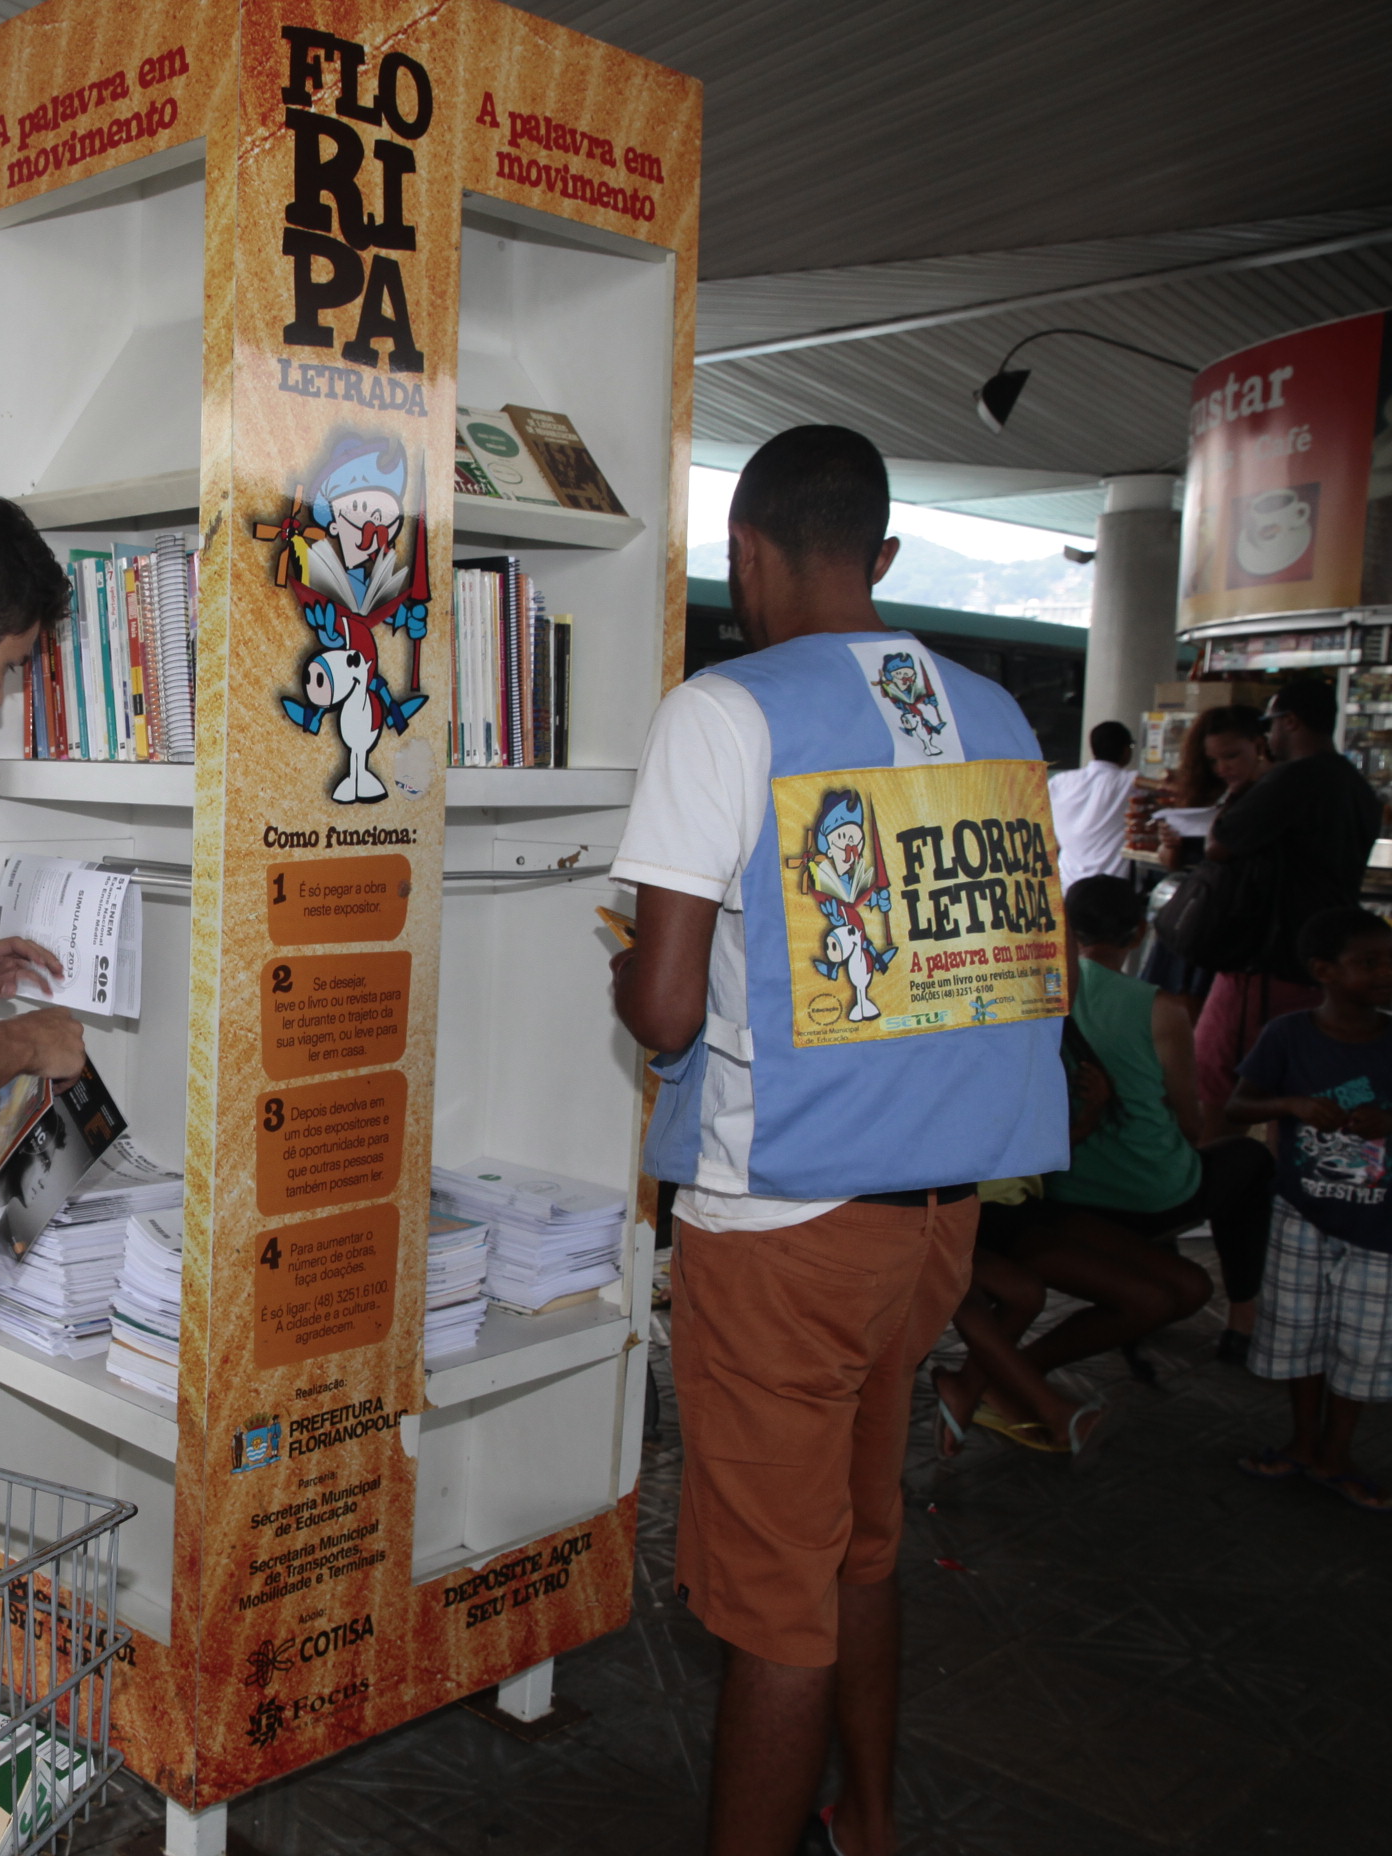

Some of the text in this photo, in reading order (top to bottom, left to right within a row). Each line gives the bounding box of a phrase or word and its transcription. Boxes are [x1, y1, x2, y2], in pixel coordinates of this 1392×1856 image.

[17, 70, 129, 152] palavra
[138, 44, 189, 89] em
[281, 25, 433, 140] FLO
[7, 97, 178, 189] movimento
[476, 91, 664, 184] A palavra em
[285, 108, 416, 252] RI
[496, 151, 655, 222] movimento
[283, 226, 425, 374] PA
[277, 357, 428, 418] LETRADA
[1255, 424, 1312, 460] Café
[263, 826, 418, 848] Como funciona:
[896, 818, 1053, 887] FLORIPA
[273, 873, 286, 905] 1
[299, 880, 386, 901] É só pegar a obra
[106, 878, 124, 936] S1 ENEM
[304, 902, 381, 917] neste expositor.
[901, 880, 1056, 942] LETRADA
[67, 890, 85, 978] SIMULADO 2013
[910, 952, 922, 973] A
[925, 948, 989, 978] palavra
[992, 944, 1013, 963] em
[272, 964, 293, 994] 2
[313, 975, 366, 991] Se desejar,
[910, 969, 1016, 992] Pegue um livro ou revista.
[911, 984, 994, 1003] DOAÇÕES (48) 3251-6100
[274, 989, 401, 1013] leve o livro ou revista para
[282, 1007, 393, 1030] ler durante o trajeto da
[276, 1024, 398, 1050] sua viagem, ou leve para
[308, 1044, 366, 1062] ler em casa.
[264, 1098, 284, 1132] 3
[290, 1097, 385, 1122] Depois devolva em
[284, 1115, 389, 1141] um dos expositores e
[283, 1132, 389, 1161] dê oportunidade para
[288, 1152, 384, 1180] que outras pessoas
[286, 1169, 384, 1198] também possam ler.
[260, 1237, 282, 1270] 4
[288, 1244, 376, 1272] número de obras,
[290, 1231, 373, 1257] Para aumentar o
[295, 1262, 366, 1287] faça doações.
[262, 1280, 389, 1322] É só ligar: (48) 3251.6100.
[276, 1320, 284, 1334] A
[286, 1312, 321, 1332] cidade
[324, 1314, 330, 1322] e
[333, 1311, 339, 1320] a
[296, 1320, 355, 1345] agradecem.
[296, 1378, 348, 1400] Realização:
[289, 1396, 384, 1438] PREFEITURA
[298, 1471, 338, 1490] Parceria:
[251, 1476, 381, 1530] Secretaria Municipal
[275, 1501, 358, 1538] de Educação
[249, 1519, 380, 1576] Secretaria Municipal
[239, 1549, 386, 1612] Mobilidade e Terminais
[265, 1544, 363, 1586] de Transportes,
[443, 1532, 593, 1609] DEPOSITE AQUI
[466, 1568, 570, 1630] SEU LIVRO
[298, 1607, 327, 1626] Apoio:
[299, 1613, 375, 1664] COTISA
[292, 1676, 370, 1722] Focus
